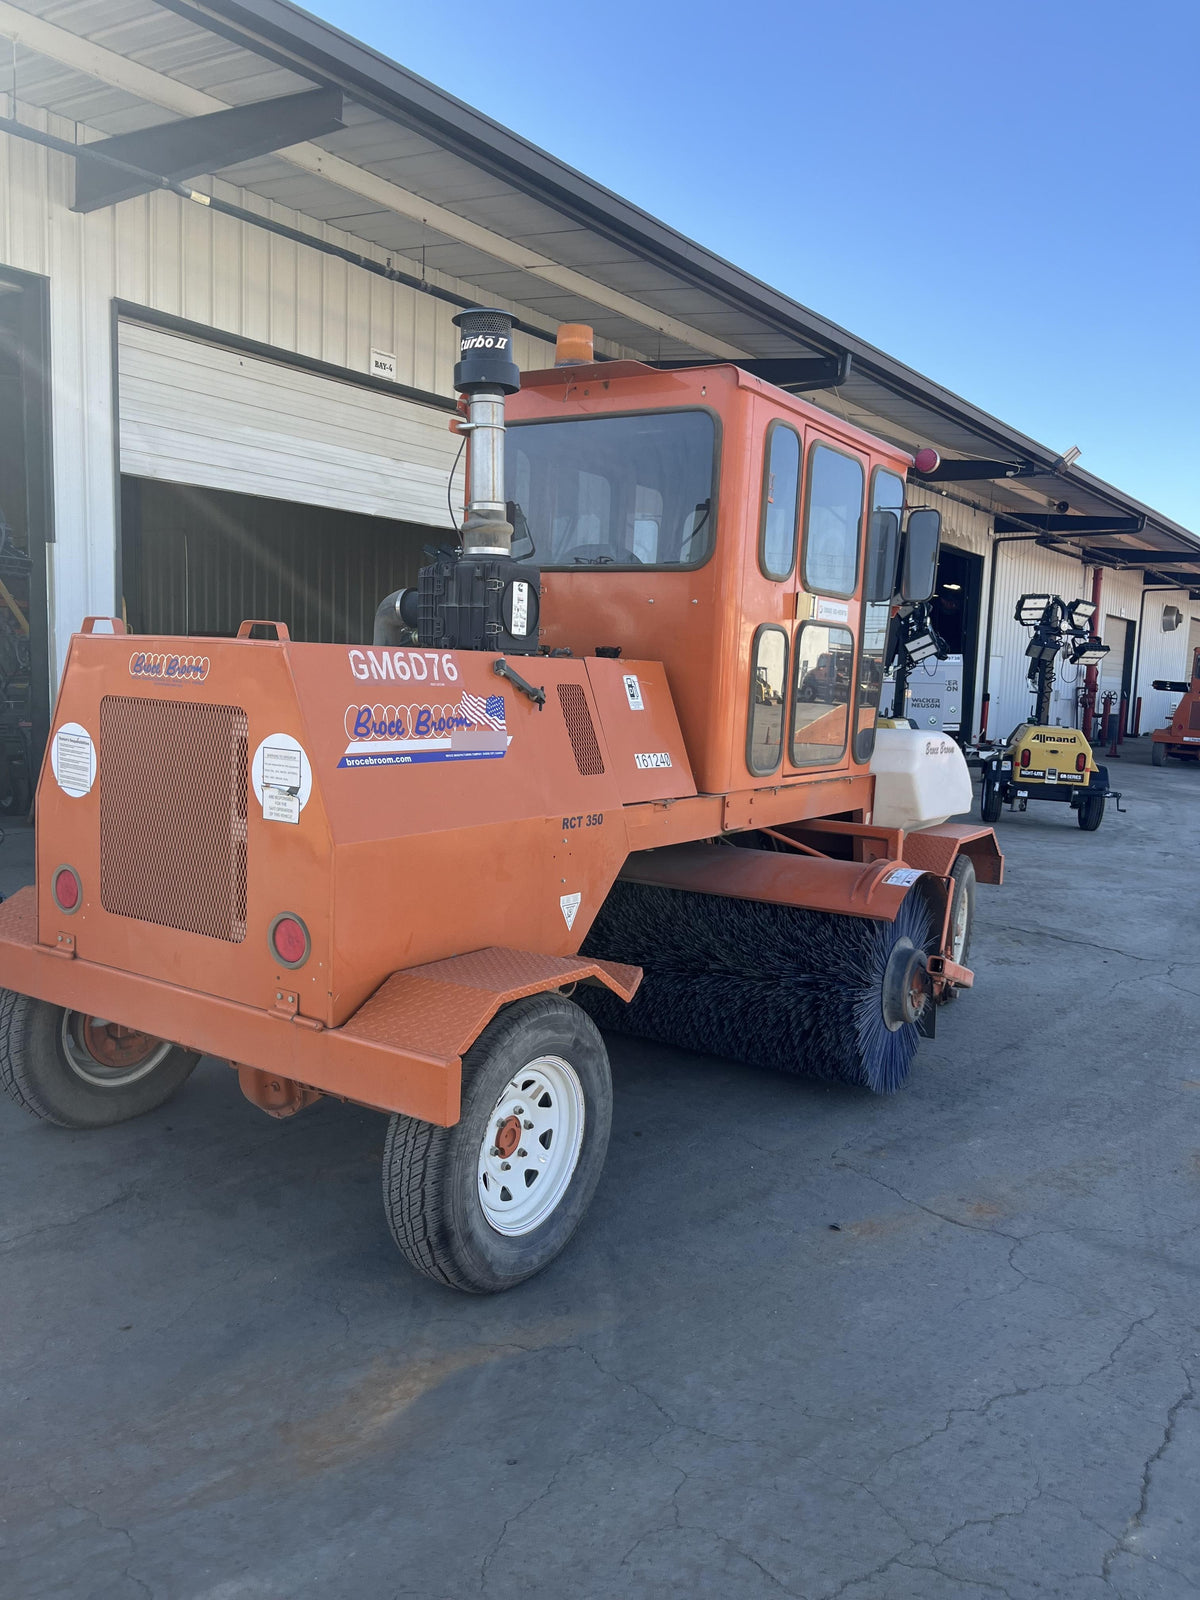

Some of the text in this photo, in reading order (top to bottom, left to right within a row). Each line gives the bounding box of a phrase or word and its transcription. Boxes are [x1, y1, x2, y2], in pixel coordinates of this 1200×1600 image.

[461, 335, 494, 351] turbo
[374, 360, 393, 372] BAY-4
[133, 654, 205, 676] Broce Broom
[348, 649, 458, 681] GM6D76
[353, 707, 472, 737] Broce Broom
[1032, 733, 1077, 743] Allmand
[346, 755, 412, 767] brocebroom.com
[636, 753, 671, 768] 161240
[562, 813, 603, 830] RCT 350
